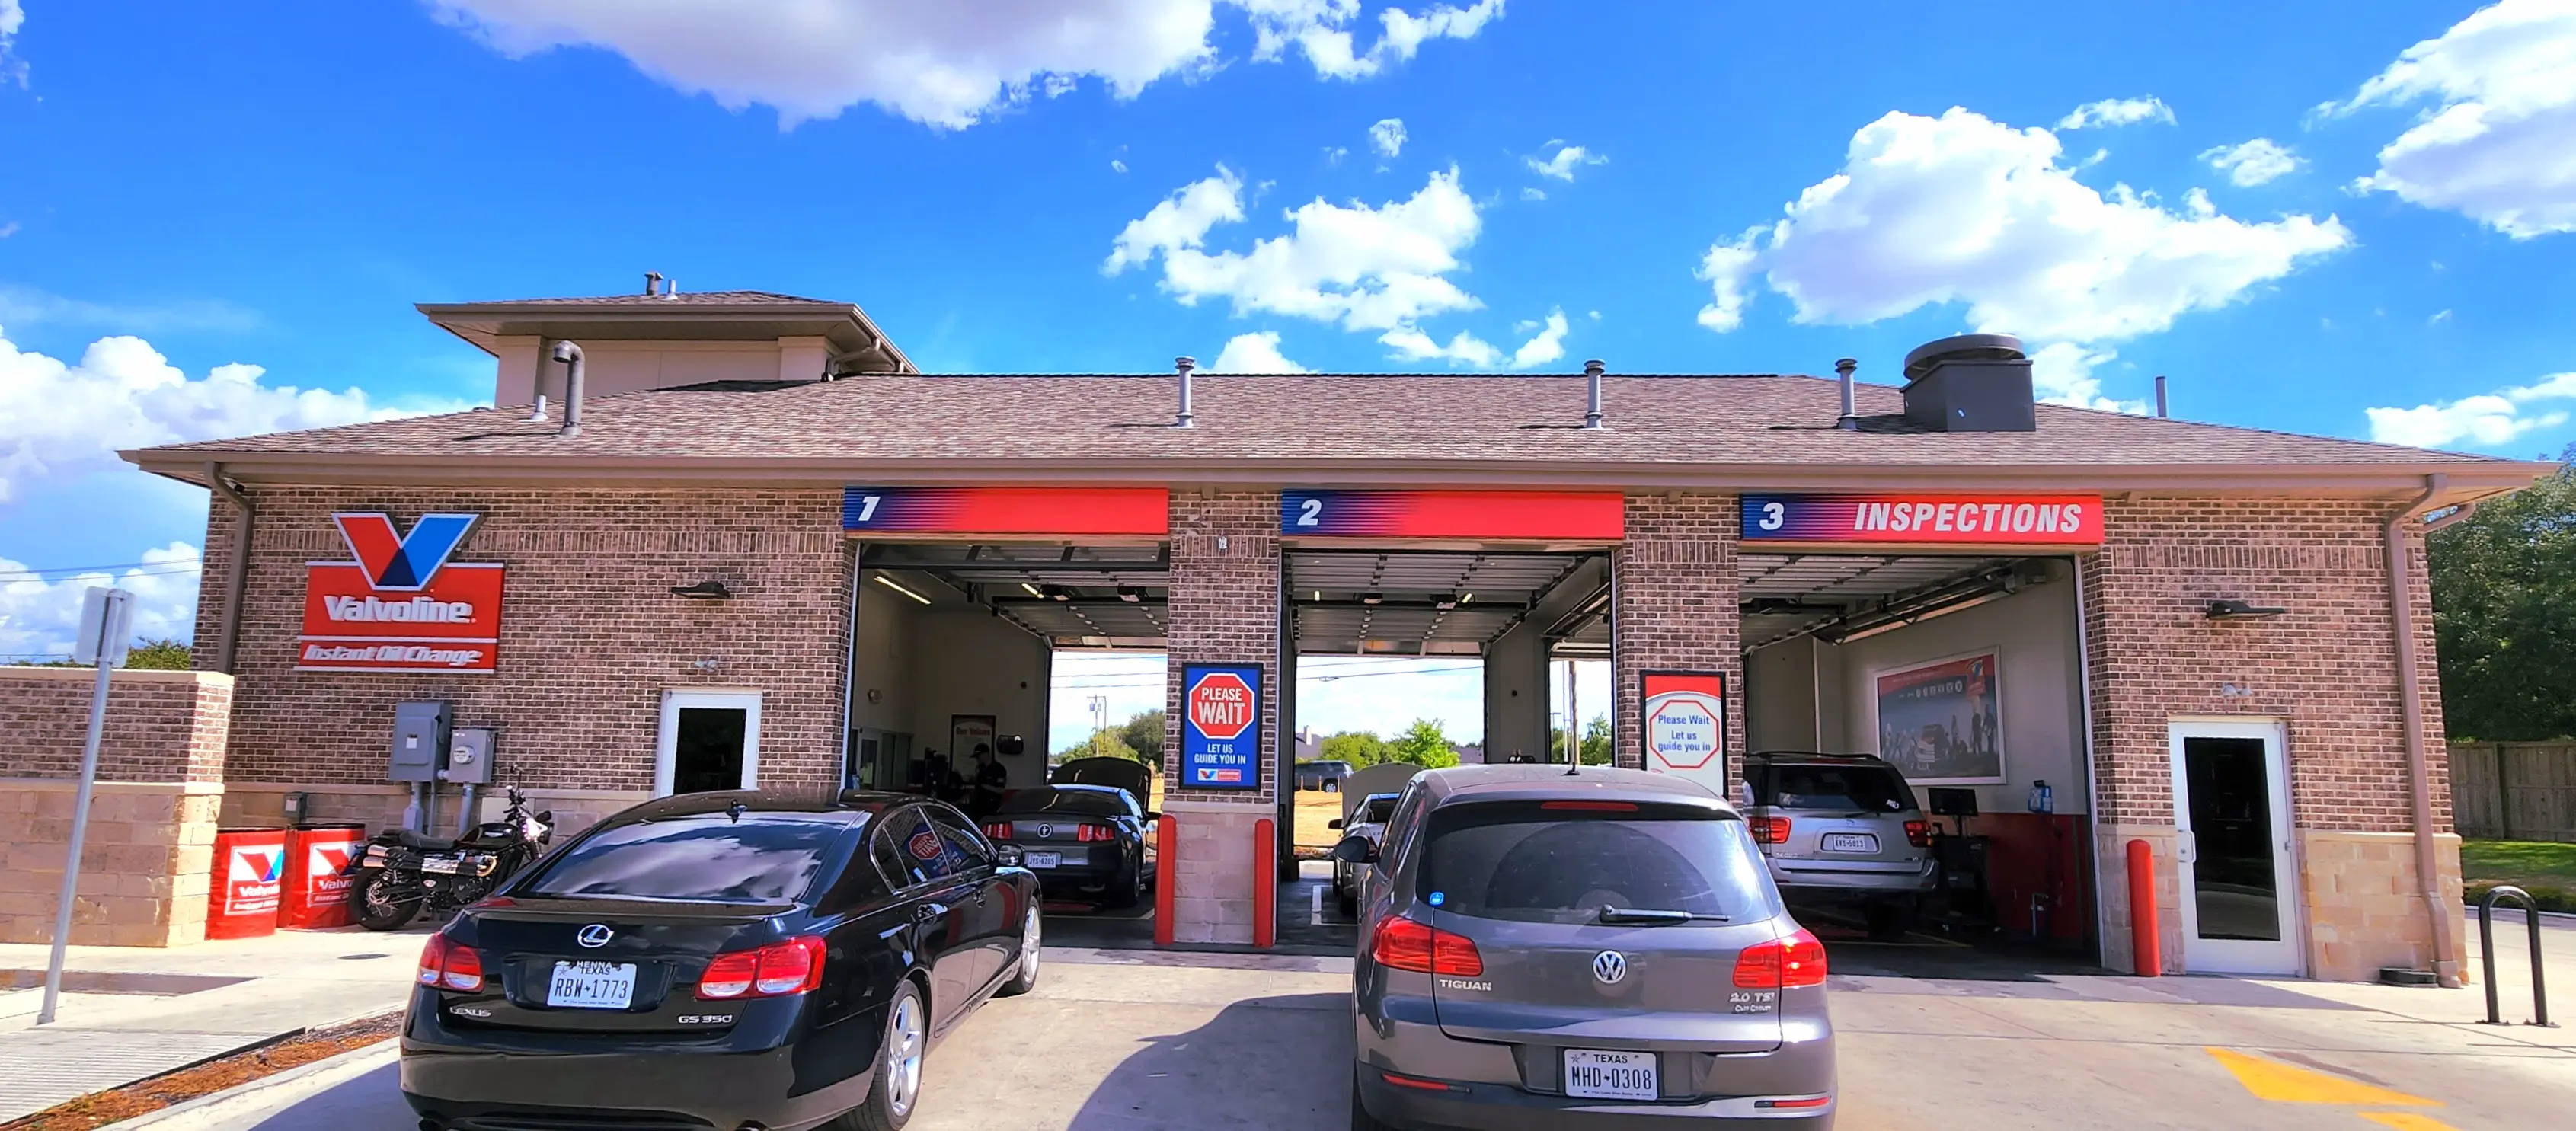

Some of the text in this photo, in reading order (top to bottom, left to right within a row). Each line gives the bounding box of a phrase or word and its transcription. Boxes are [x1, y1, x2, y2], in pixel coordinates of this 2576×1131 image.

[858, 497, 881, 521] 1
[1297, 499, 1322, 526] 2
[1759, 502, 2082, 533] 3 INSPECTIONS
[323, 595, 473, 623] Valvoline
[303, 644, 484, 666] Instant Oil Change
[1201, 687, 1243, 701] PLEASE
[1197, 701, 1245, 724] WAIT
[1658, 715, 1710, 725] Please Wait
[1671, 730, 1685, 740] Let
[1207, 743, 1233, 754] LET US
[1658, 741, 1711, 753] guide you in
[1194, 754, 1246, 765] GUIDE YOU IN
[577, 960, 612, 969] HENNA
[580, 966, 611, 976] TEXAS
[1439, 979, 1491, 991] TIGUAN
[449, 1006, 492, 1018] LEXUS
[678, 1014, 733, 1024] GS 350
[1593, 1054, 1628, 1064] TEXAS
